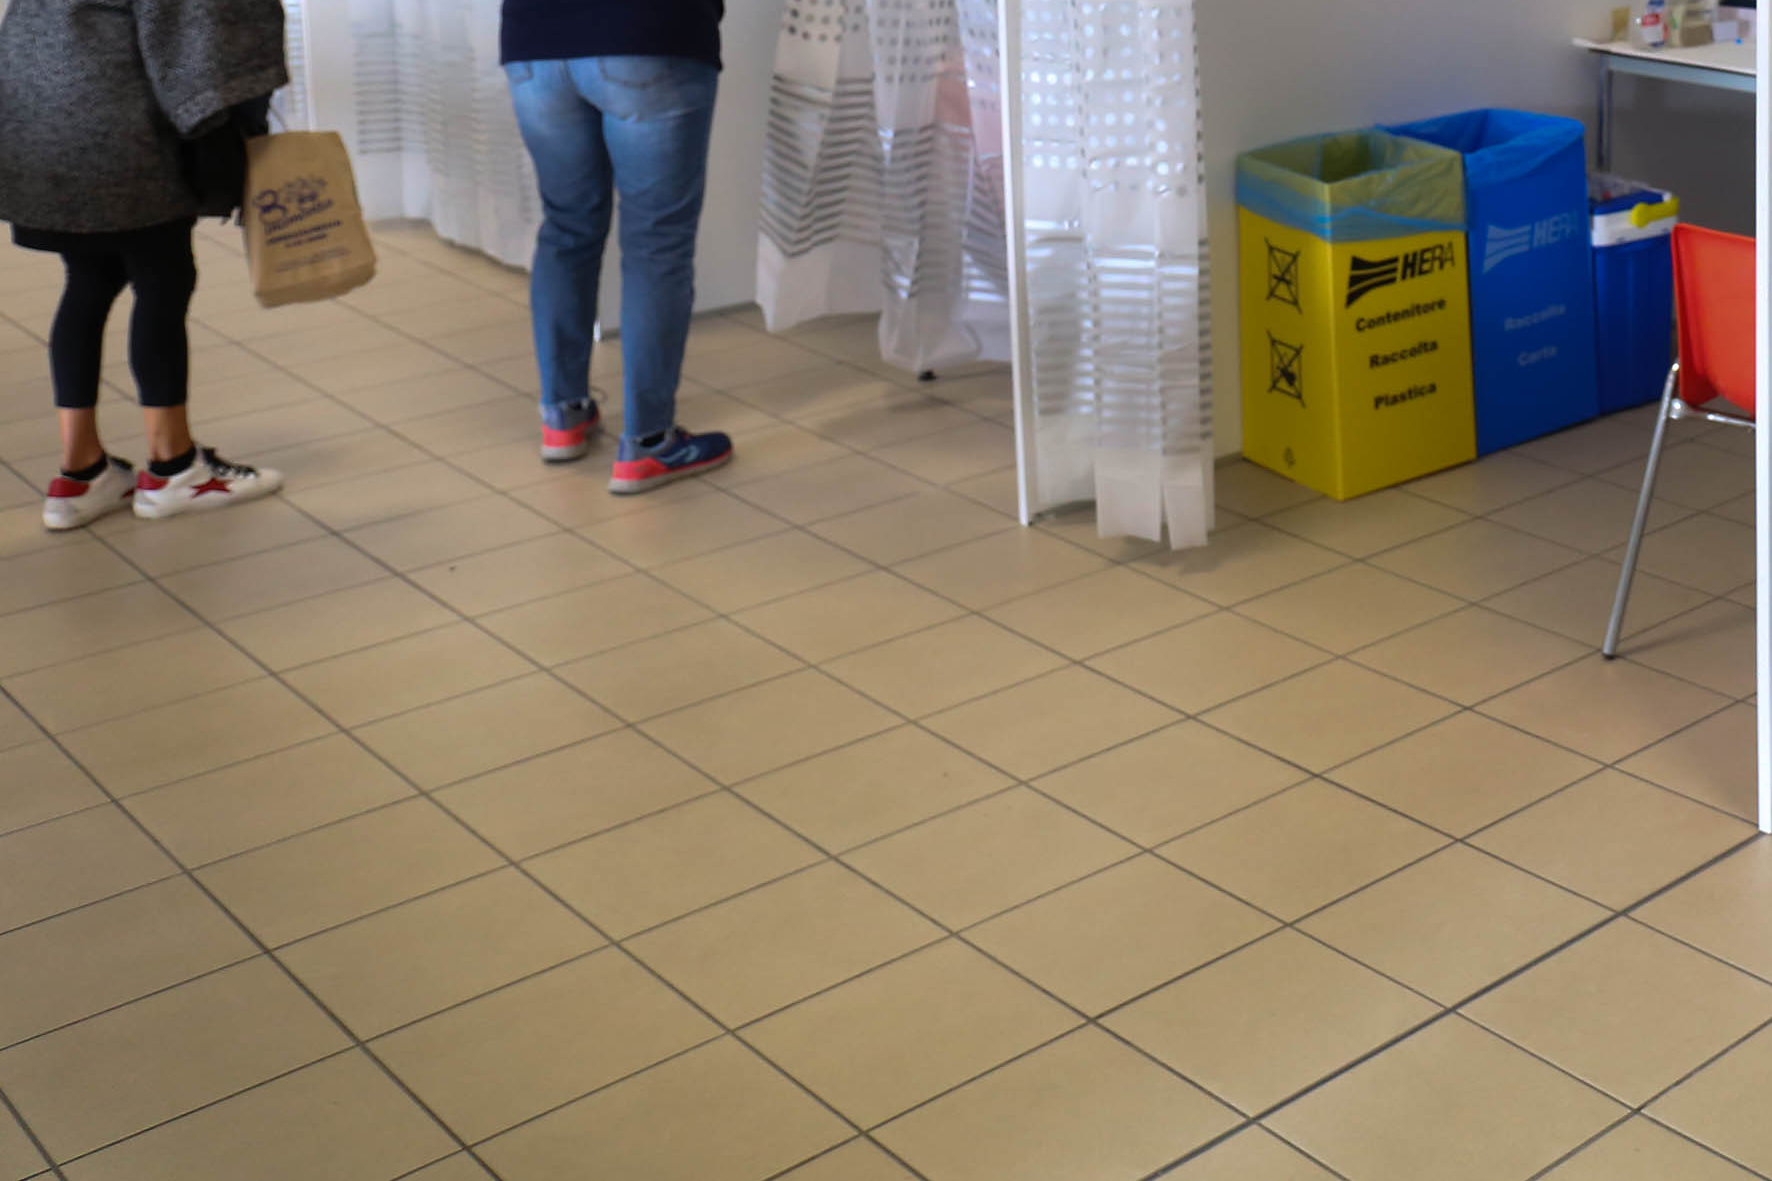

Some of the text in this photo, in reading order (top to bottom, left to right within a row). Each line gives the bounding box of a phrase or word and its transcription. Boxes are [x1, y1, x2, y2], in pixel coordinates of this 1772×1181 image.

[1401, 241, 1455, 280] HERA
[1355, 298, 1446, 332] Contenitore
[1369, 340, 1439, 368] Raccolta
[1374, 382, 1437, 410] Plastica
